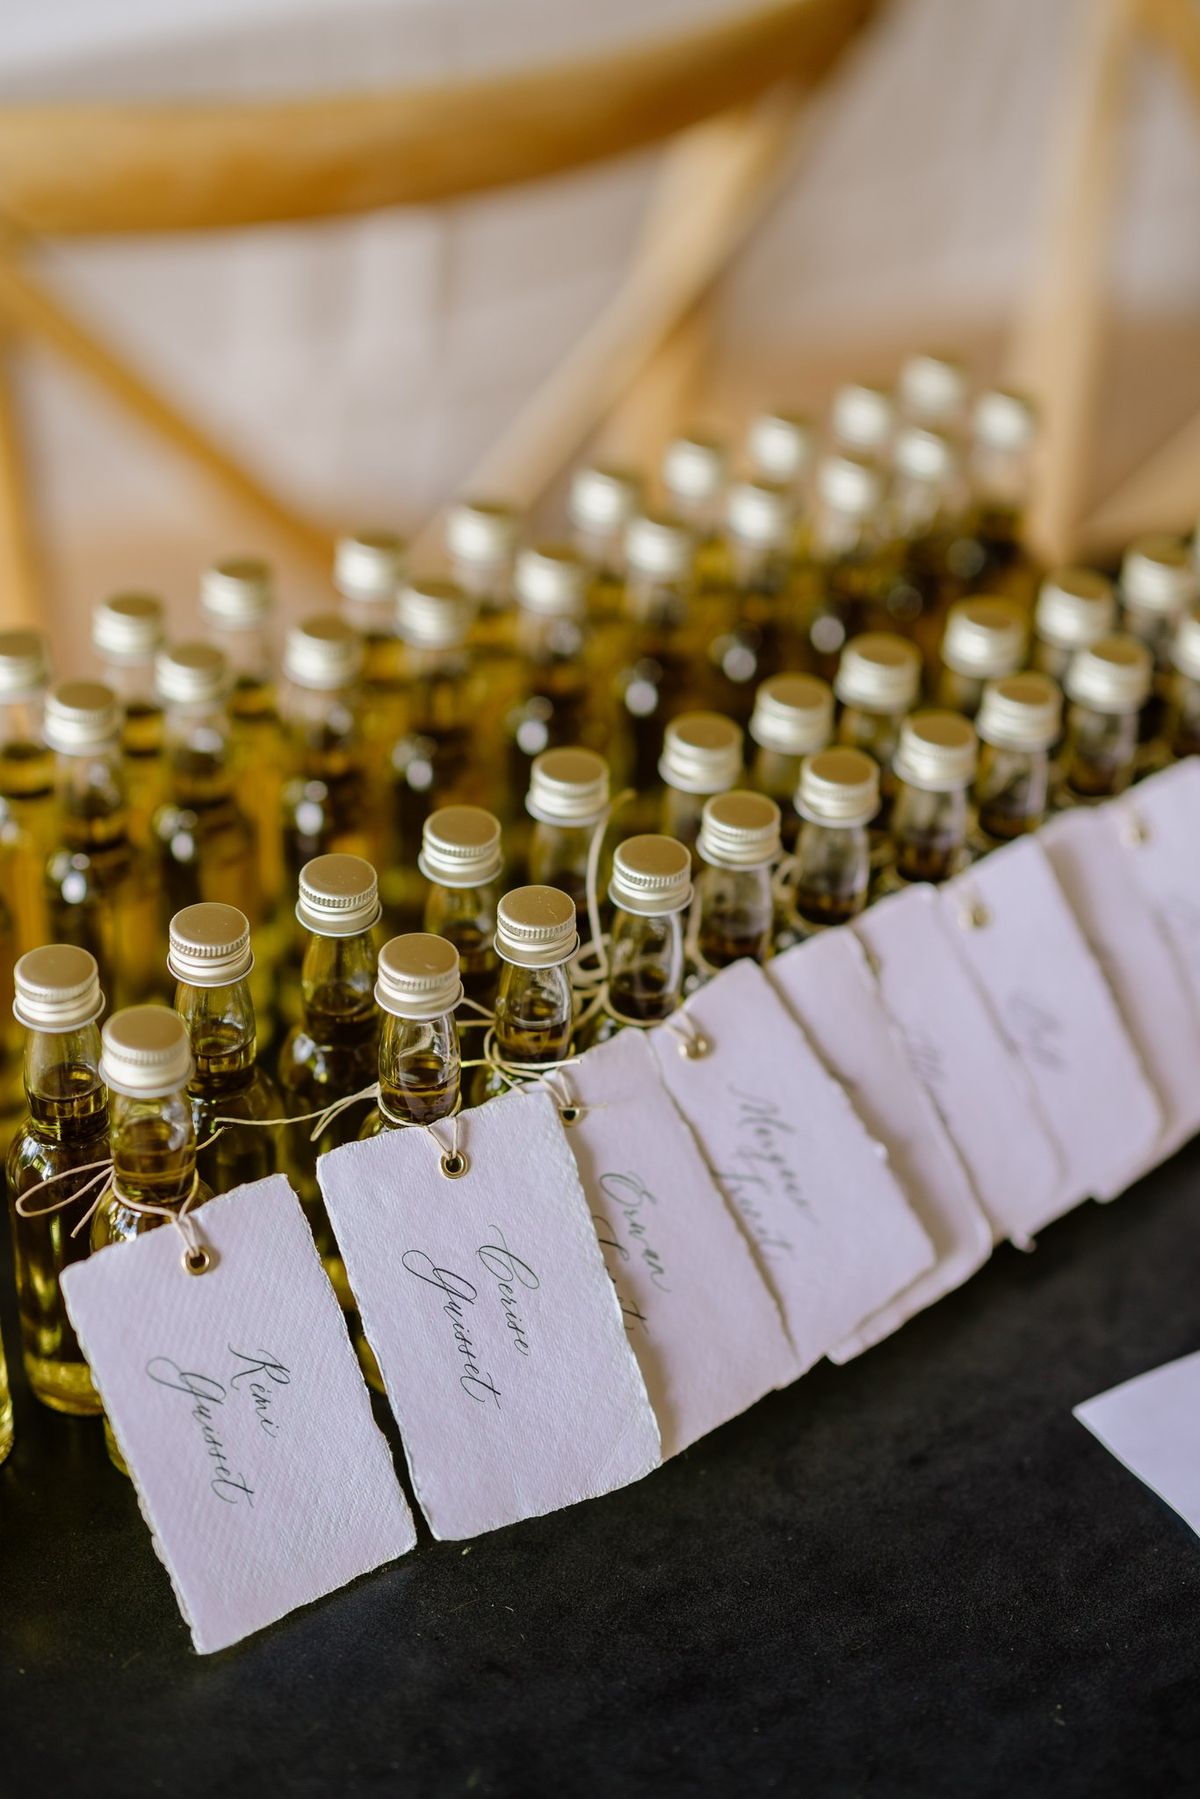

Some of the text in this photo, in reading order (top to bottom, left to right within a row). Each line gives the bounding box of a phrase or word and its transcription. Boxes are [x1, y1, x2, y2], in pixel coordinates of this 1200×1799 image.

[401, 1249, 502, 1410] Guisset
[475, 1224, 540, 1357] Cerise
[145, 1356, 255, 1509] Guisset
[227, 1342, 292, 1439] Rémi
